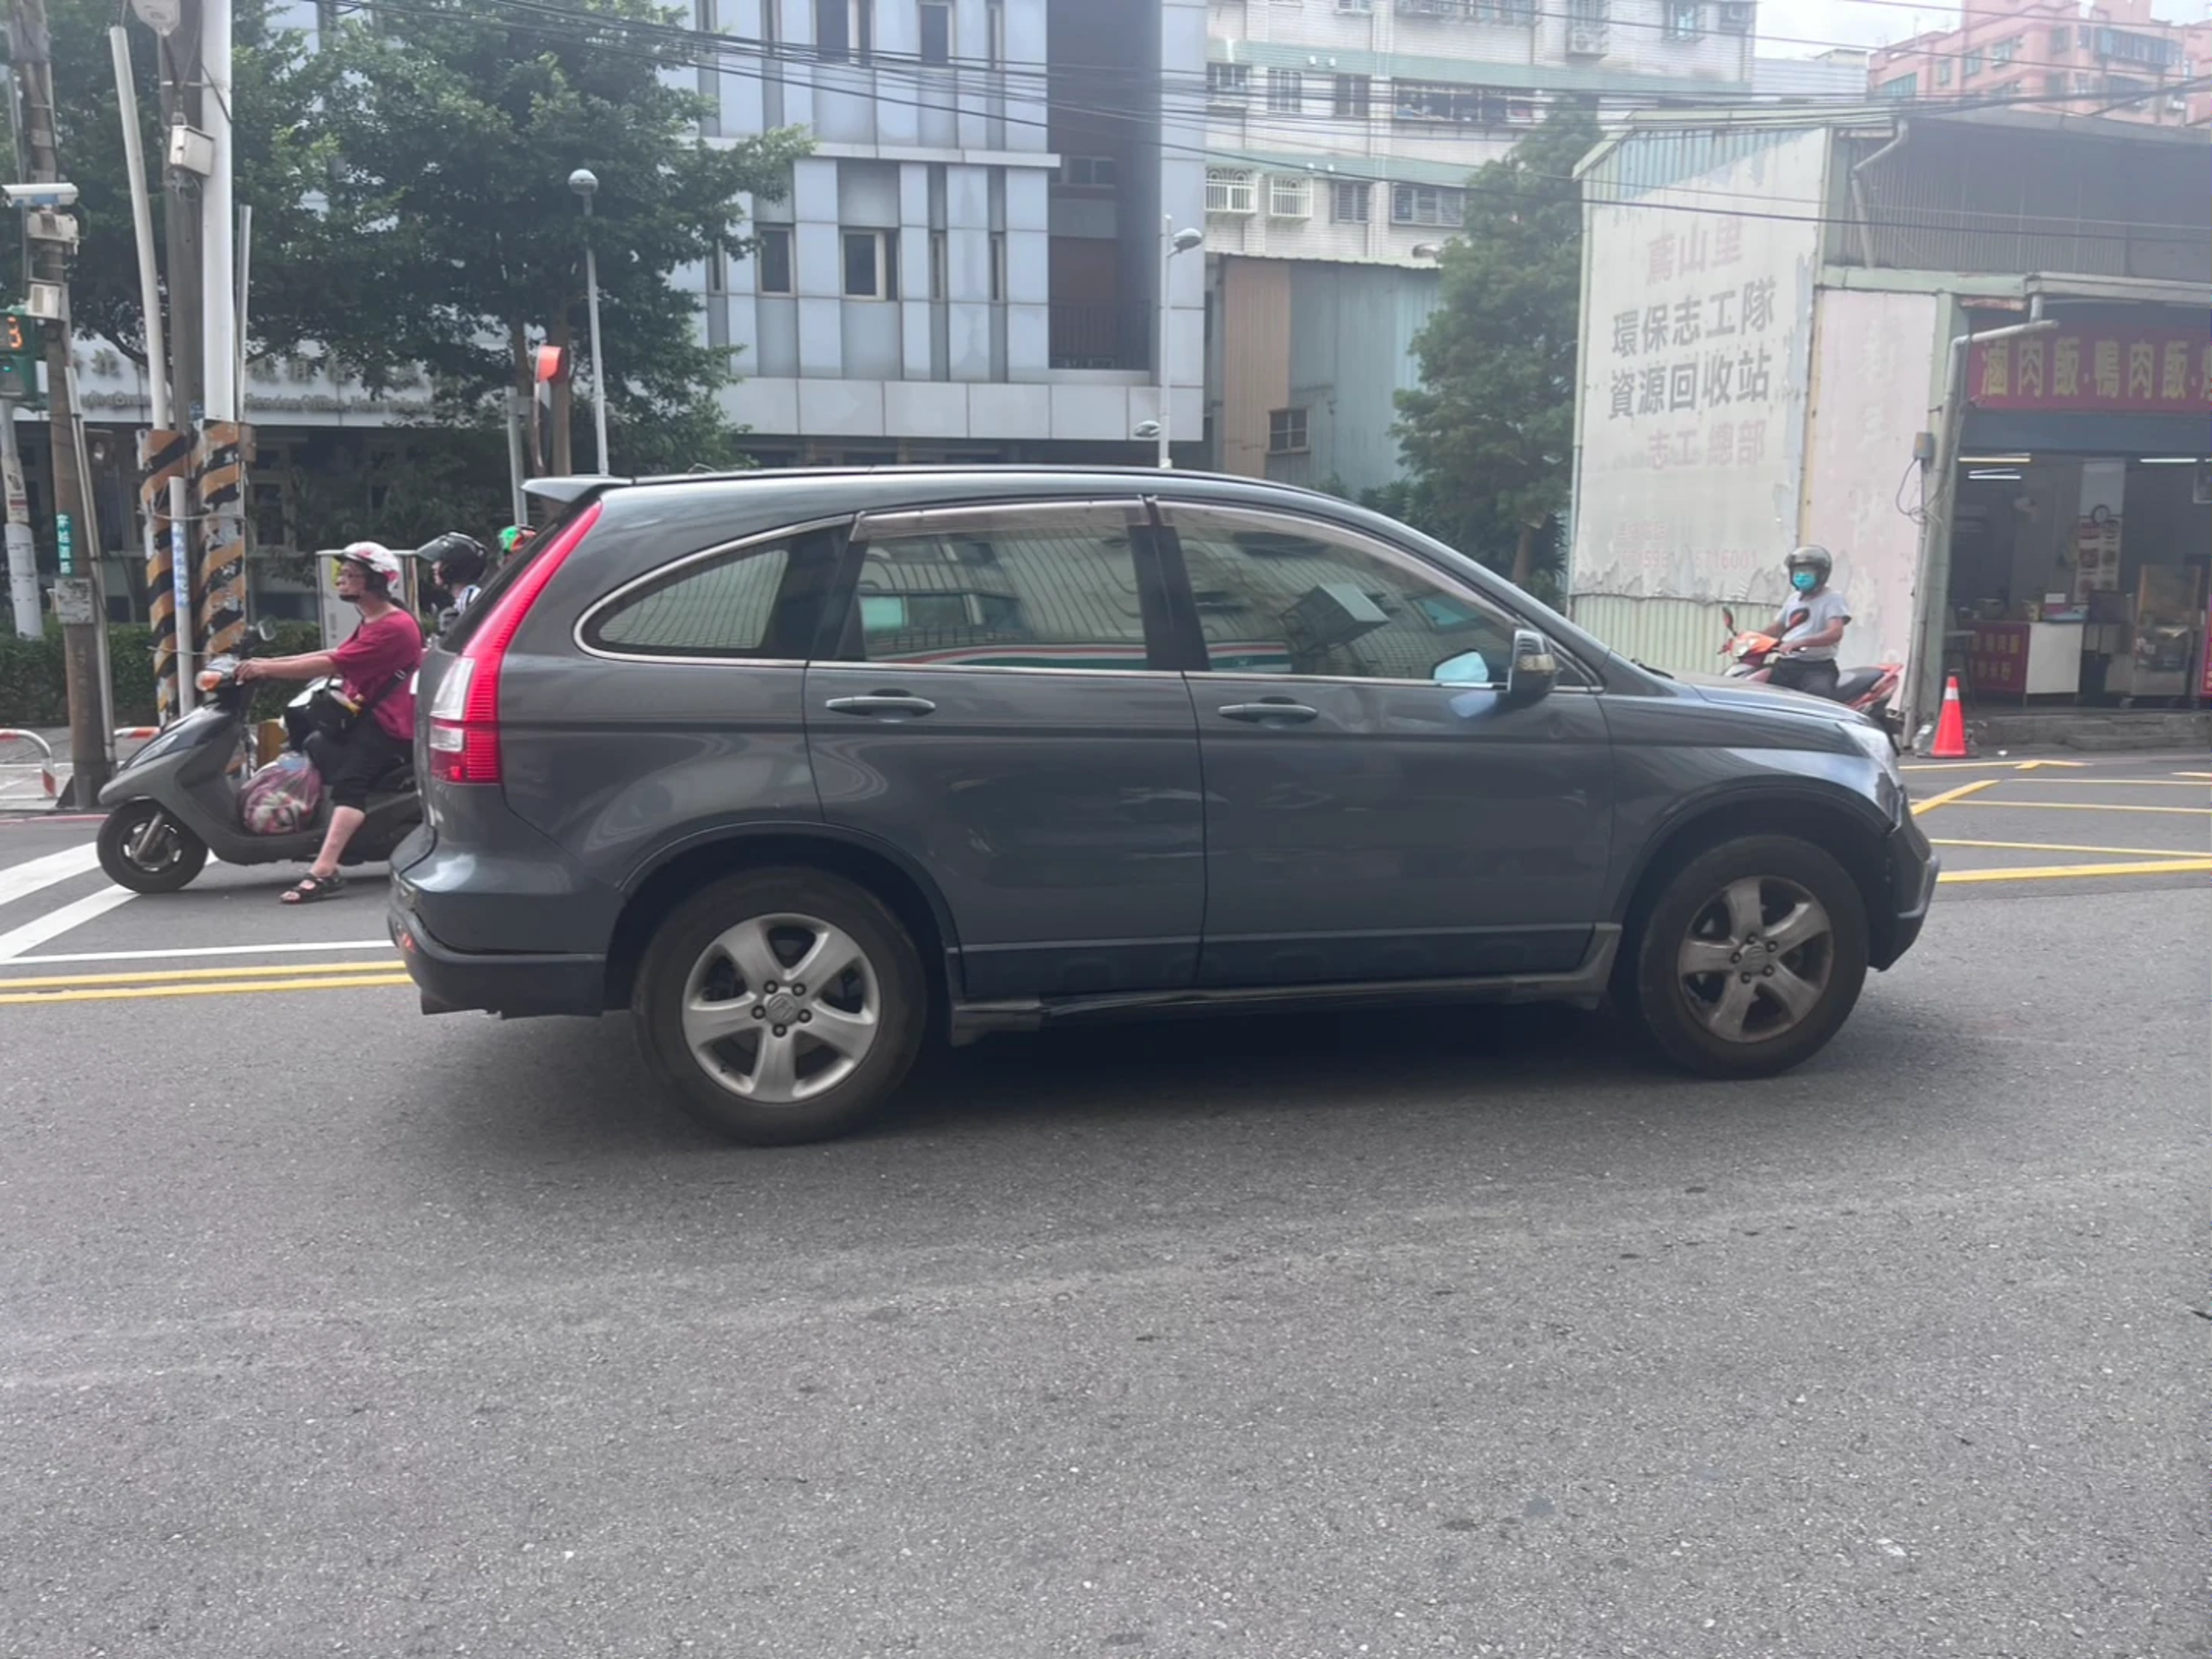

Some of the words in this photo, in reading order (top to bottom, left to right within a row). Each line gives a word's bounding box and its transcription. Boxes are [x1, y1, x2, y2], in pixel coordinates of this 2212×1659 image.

[1611, 277, 1777, 359] 環保志工隊
[1608, 344, 1772, 420] 資源回收站
[1646, 419, 1766, 470] 志工總部
